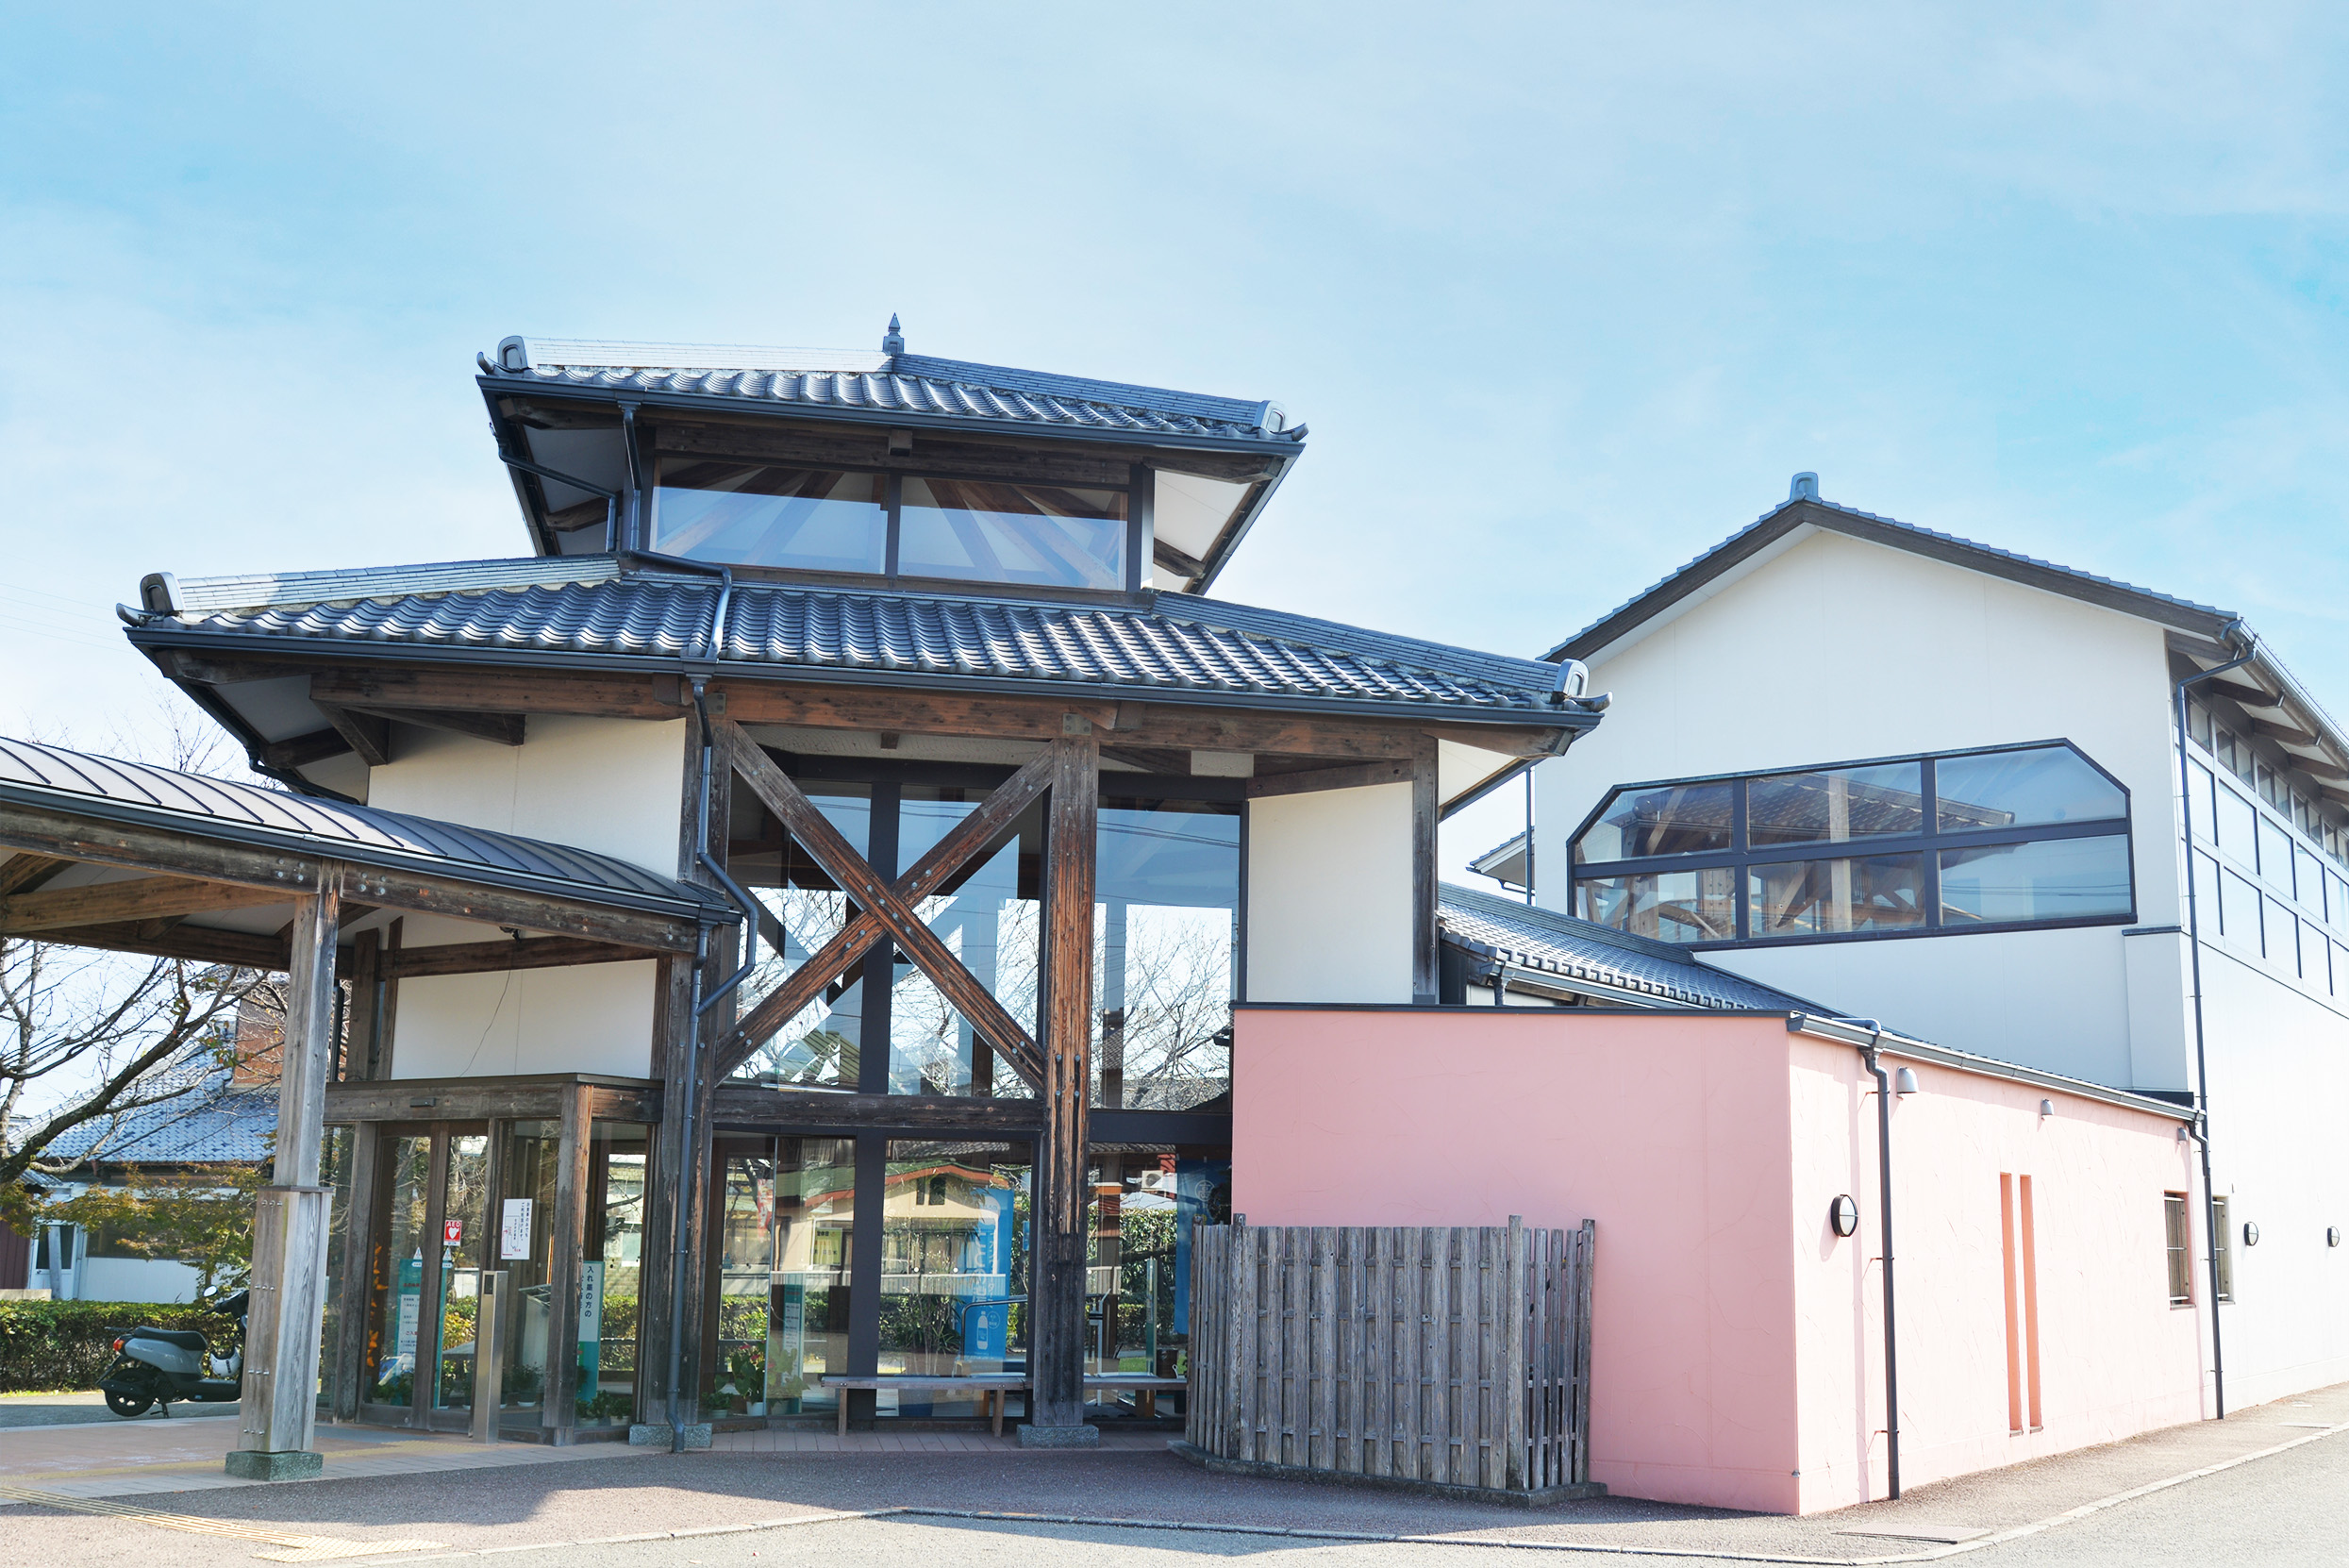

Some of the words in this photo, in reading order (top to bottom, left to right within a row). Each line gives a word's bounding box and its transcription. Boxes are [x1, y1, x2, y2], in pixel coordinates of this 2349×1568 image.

[584, 1265, 594, 1318] 入れ墨の方の
